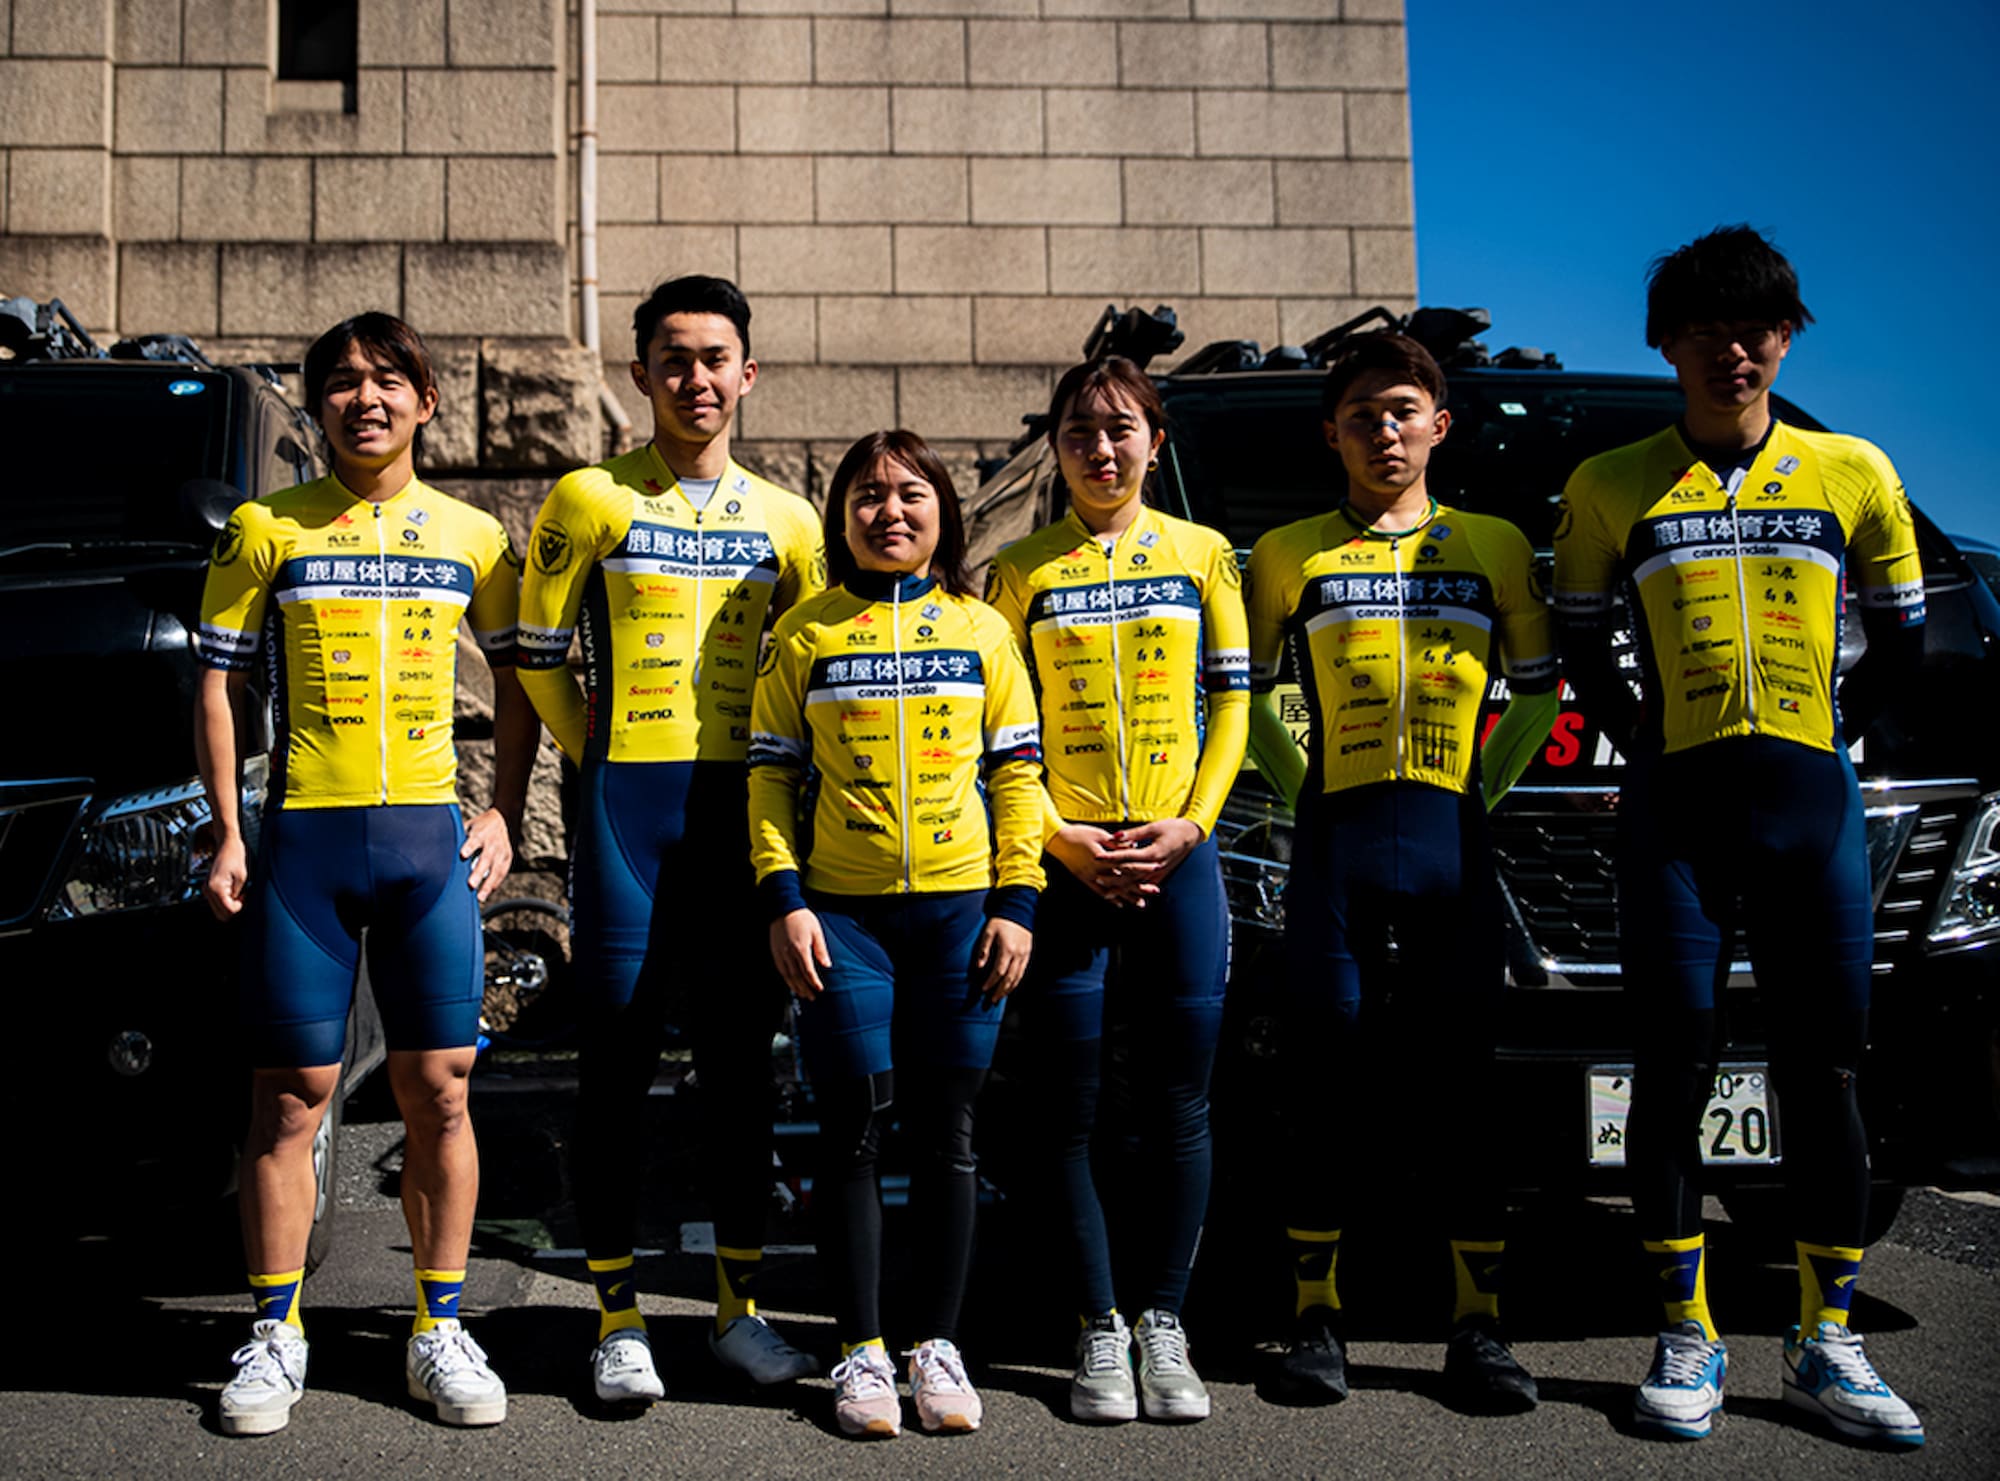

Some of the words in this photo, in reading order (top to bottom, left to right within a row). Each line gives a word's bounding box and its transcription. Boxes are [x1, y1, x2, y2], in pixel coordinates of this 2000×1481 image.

[1653, 514, 1823, 547] 鹿屋体育大学
[627, 528, 773, 561] 鹿屋体育大学
[1693, 545, 1778, 558] cannondale
[305, 560, 457, 584] 鹿屋体育大学
[660, 563, 737, 577] cannondale
[341, 588, 420, 599] cannondale
[1320, 577, 1479, 605] 鹿屋体育大学
[1072, 609, 1149, 624] cannondale
[1356, 607, 1439, 618] cannondale
[1763, 634, 1804, 649] SMITH
[826, 655, 970, 683] 鹿屋体育大学
[858, 684, 936, 698] cannondale
